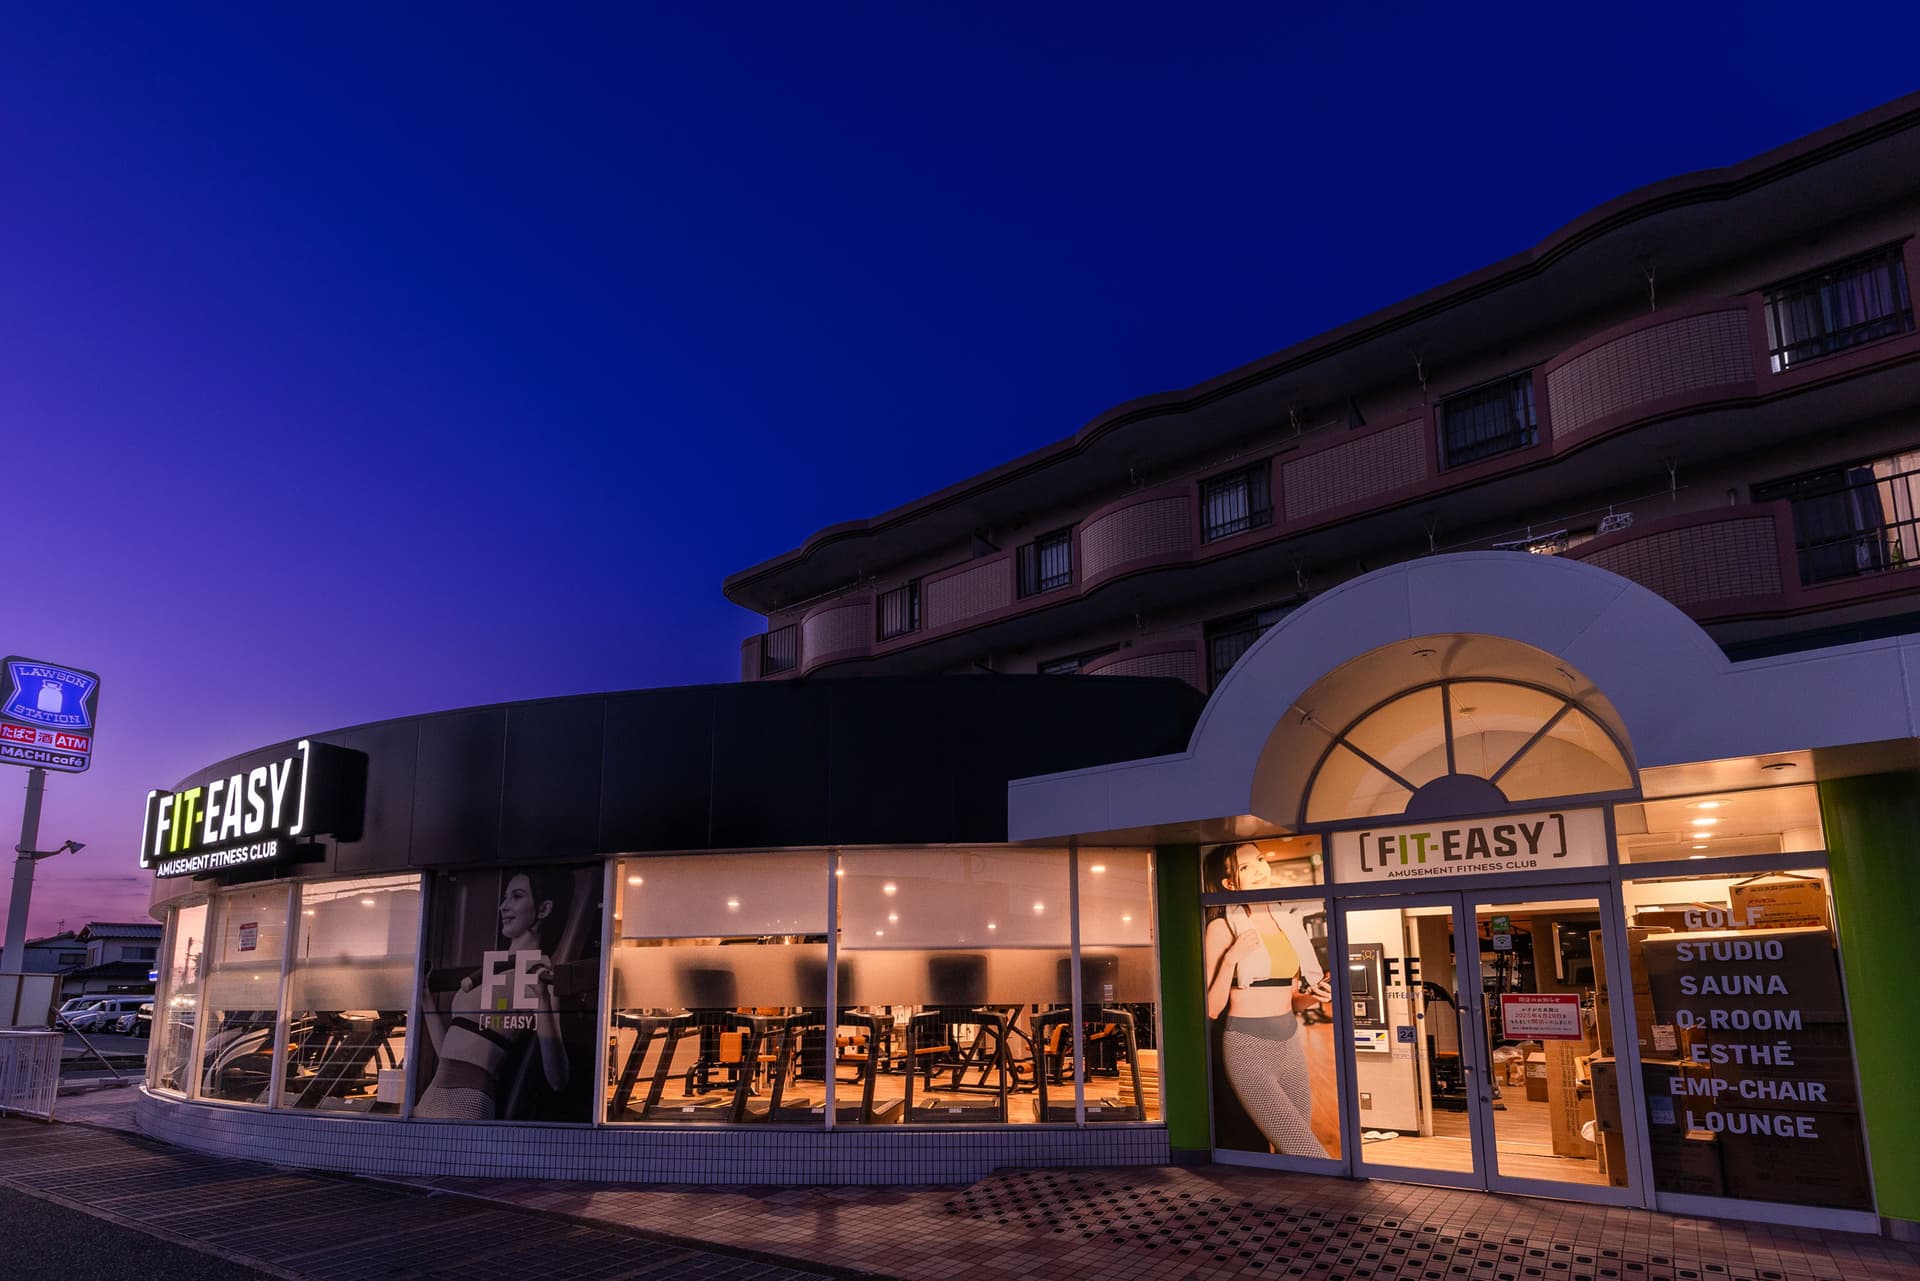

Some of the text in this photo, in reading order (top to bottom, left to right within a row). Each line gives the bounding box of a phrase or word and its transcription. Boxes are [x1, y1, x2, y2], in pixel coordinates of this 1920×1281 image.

[18, 667, 87, 688] LAWSON
[14, 704, 81, 723] STATION
[2, 726, 34, 741] たばこ
[56, 736, 87, 749] ATM
[1, 746, 51, 761] MACHI
[157, 841, 277, 877] AMUSEMENT FITNESS CLUB
[1388, 860, 1537, 878] AMUSEMENT FITNESS CLUB
[1684, 906, 1766, 929] GOLF
[1676, 940, 1783, 962] STUDIO
[1680, 975, 1789, 996] SAUNA
[1400, 1030, 1414, 1039] 24
[1669, 1076, 1828, 1103] EMP-CHAIR
[1686, 1110, 1819, 1139] LOUNGE
